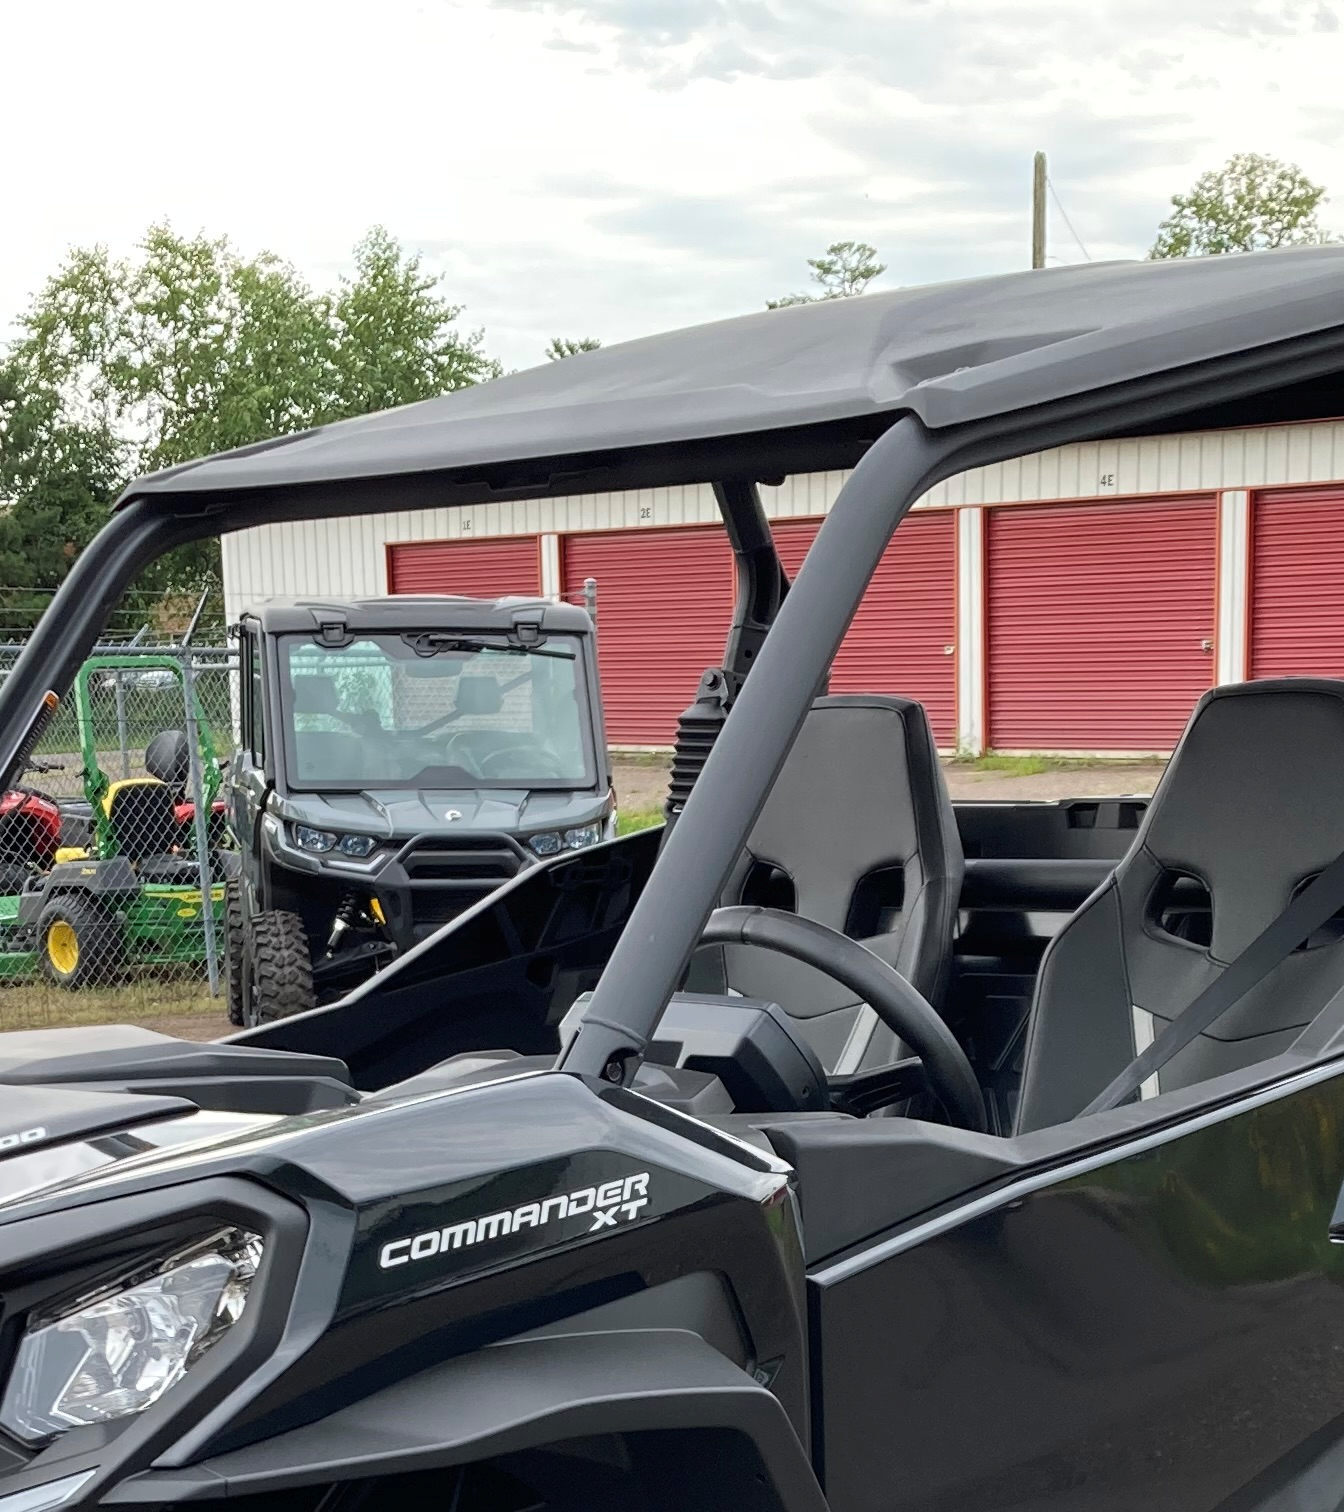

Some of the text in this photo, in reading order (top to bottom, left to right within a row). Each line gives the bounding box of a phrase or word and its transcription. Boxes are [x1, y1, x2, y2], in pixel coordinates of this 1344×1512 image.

[1100, 474, 1114, 487] 4E
[641, 508, 651, 518] 2E
[462, 520, 471, 530] 1E
[379, 1172, 650, 1269] COMMANDER
[588, 1198, 648, 1232] XT
